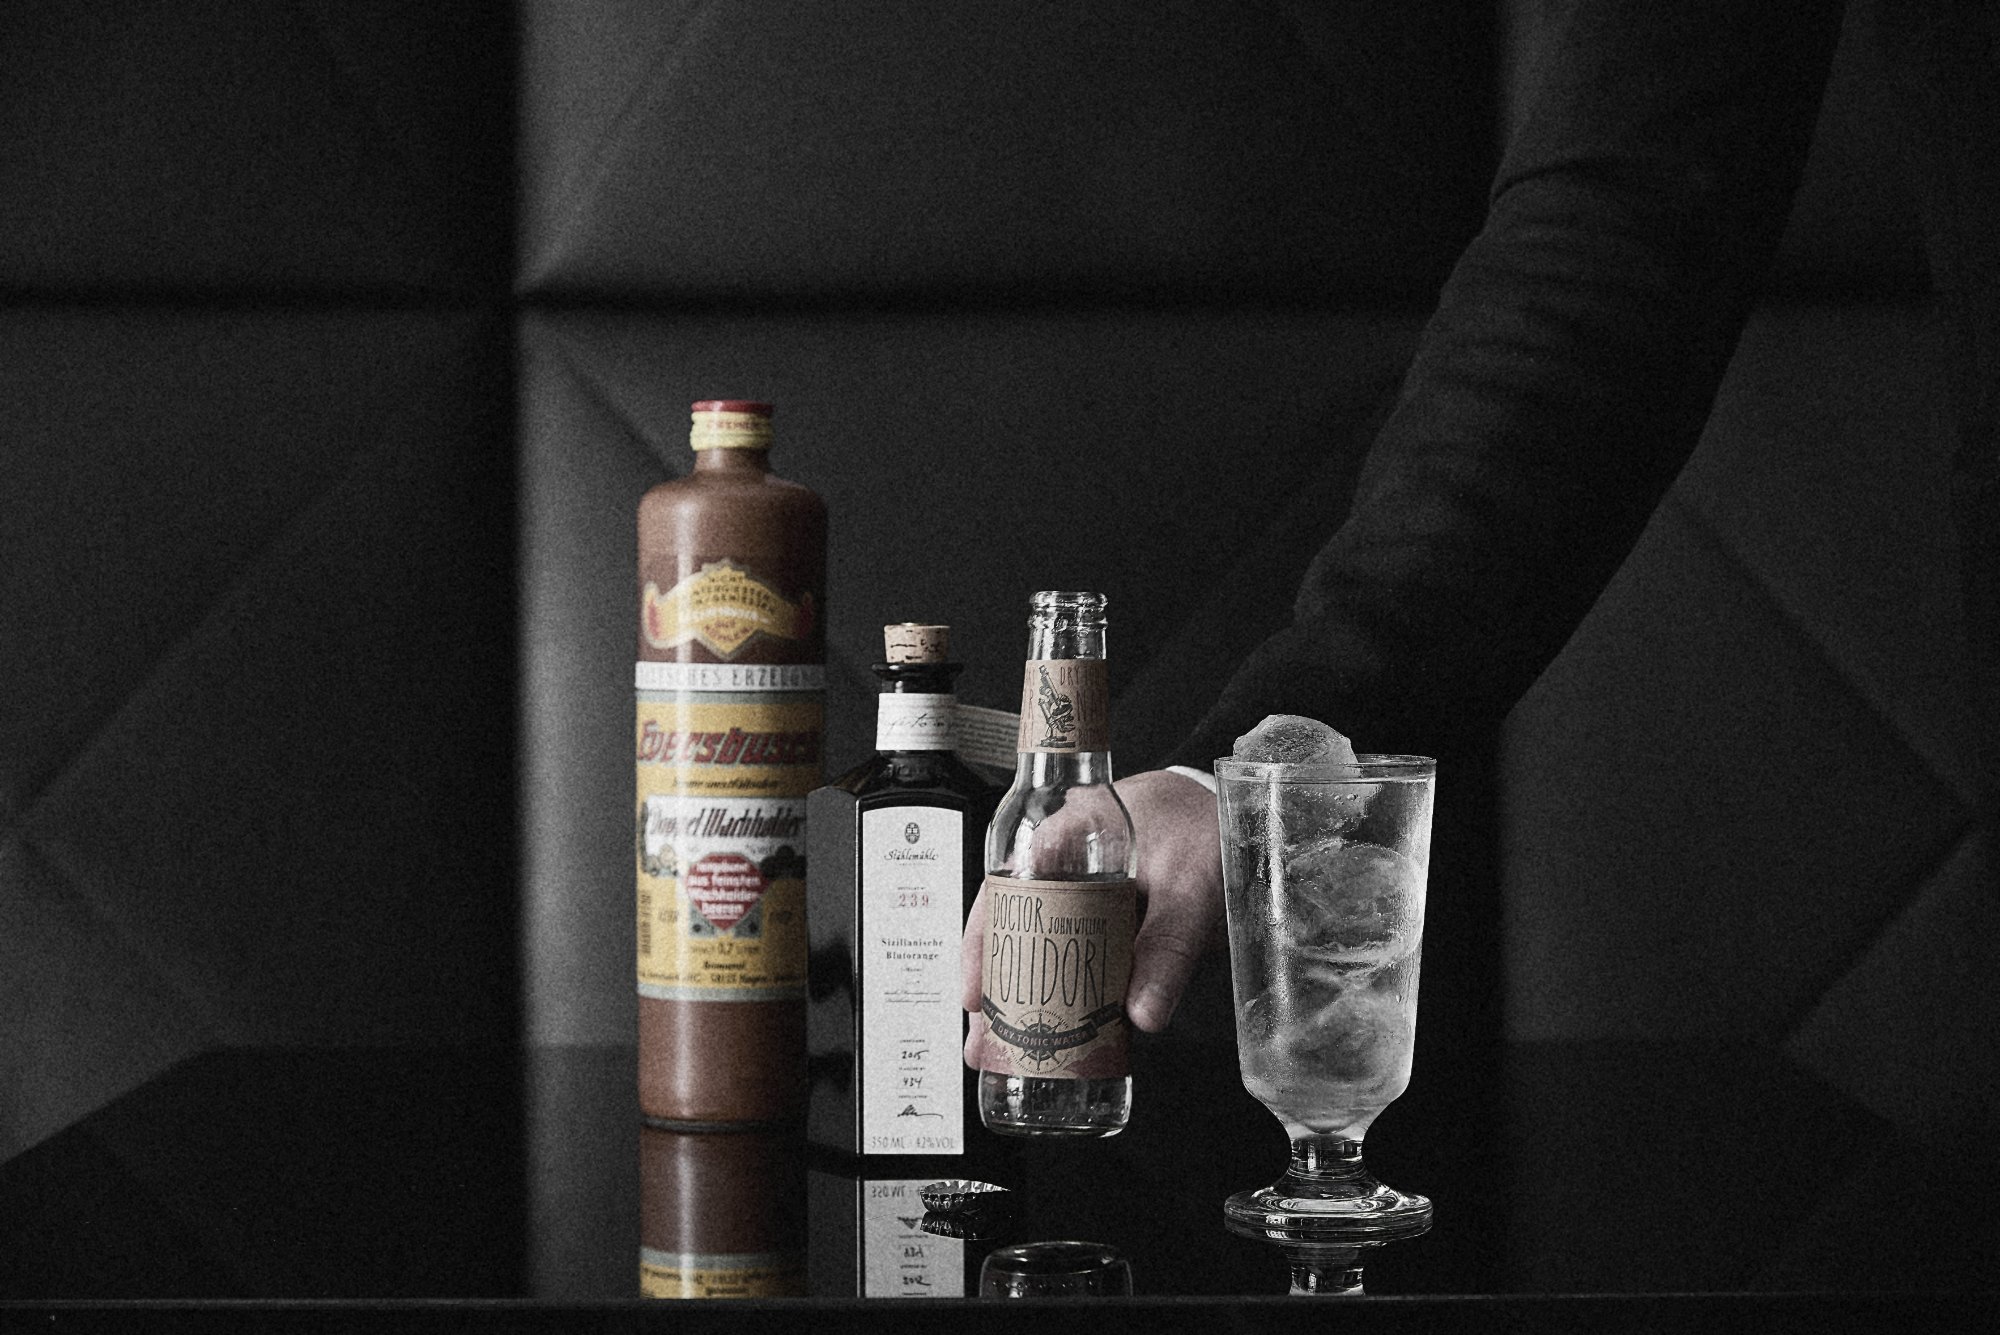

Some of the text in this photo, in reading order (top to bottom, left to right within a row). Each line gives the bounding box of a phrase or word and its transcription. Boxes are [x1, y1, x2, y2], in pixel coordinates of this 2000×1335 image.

[993, 892, 1044, 935] DOCTOR
[1048, 916, 1072, 935] JOHN
[881, 937, 943, 947] Sizilianische
[886, 951, 939, 961] Blutorange
[989, 932, 1108, 1008] POLIDORI
[997, 1024, 1089, 1047] DRY TONIC WATER
[871, 1135, 889, 1149] 350
[890, 1135, 906, 1149] ML
